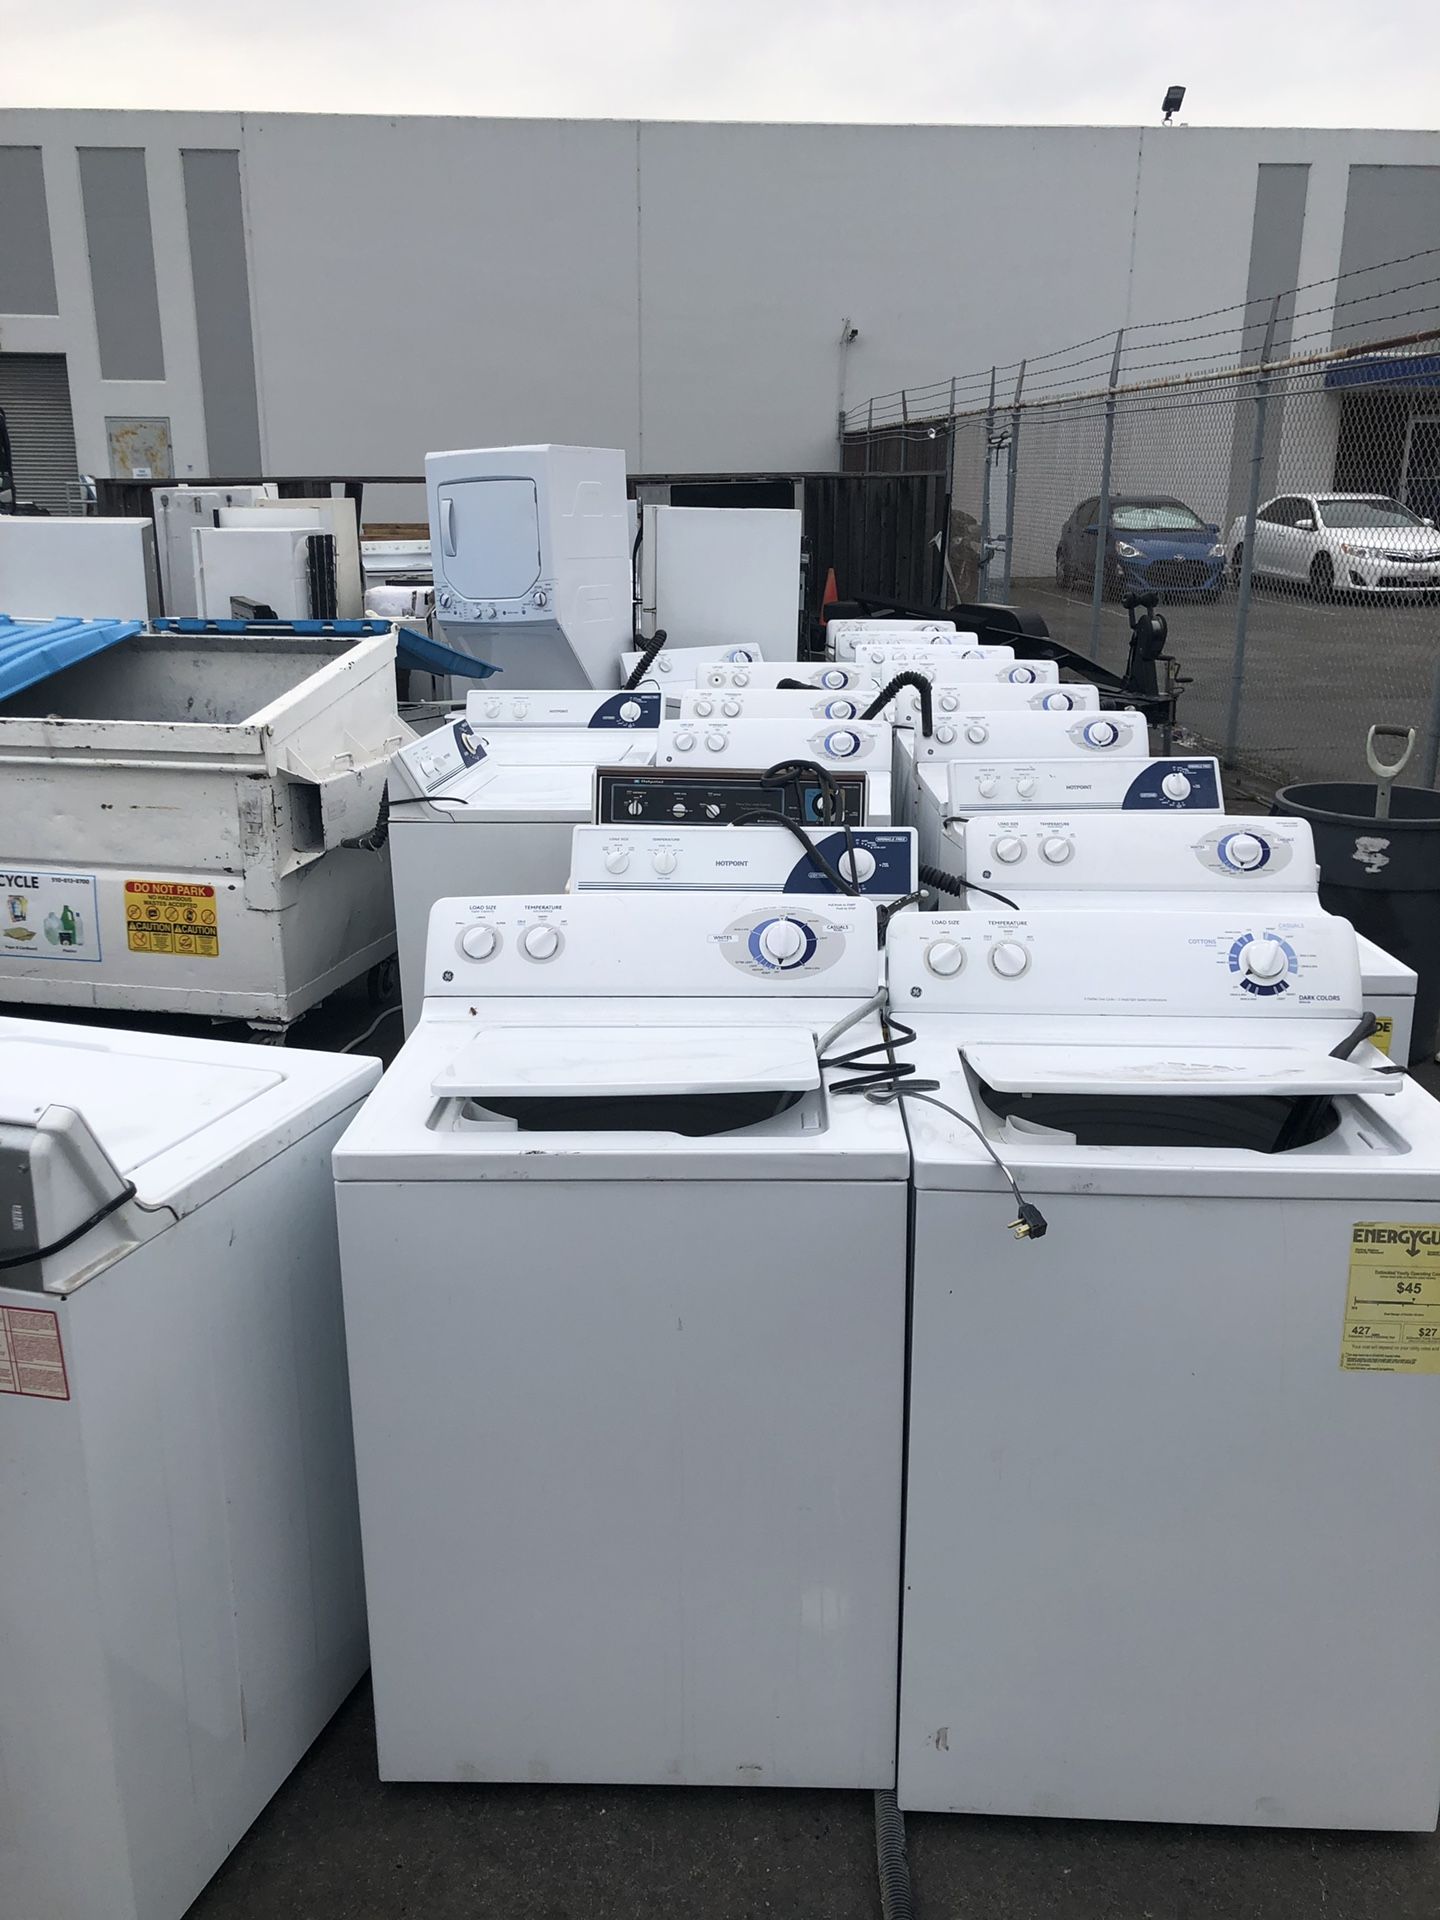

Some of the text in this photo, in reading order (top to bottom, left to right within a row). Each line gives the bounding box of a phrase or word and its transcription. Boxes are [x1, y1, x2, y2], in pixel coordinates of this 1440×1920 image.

[0, 874, 39, 889] CYCLE
[133, 883, 206, 896] DO NOT PARK
[135, 922, 171, 932] CAUTION
[182, 925, 216, 935] CAUTION
[1352, 1228, 1440, 1248] ENERGYGU
[1396, 1281, 1422, 1295] $45
[1351, 1326, 1371, 1335] 427
[1418, 1327, 1438, 1338] $27
